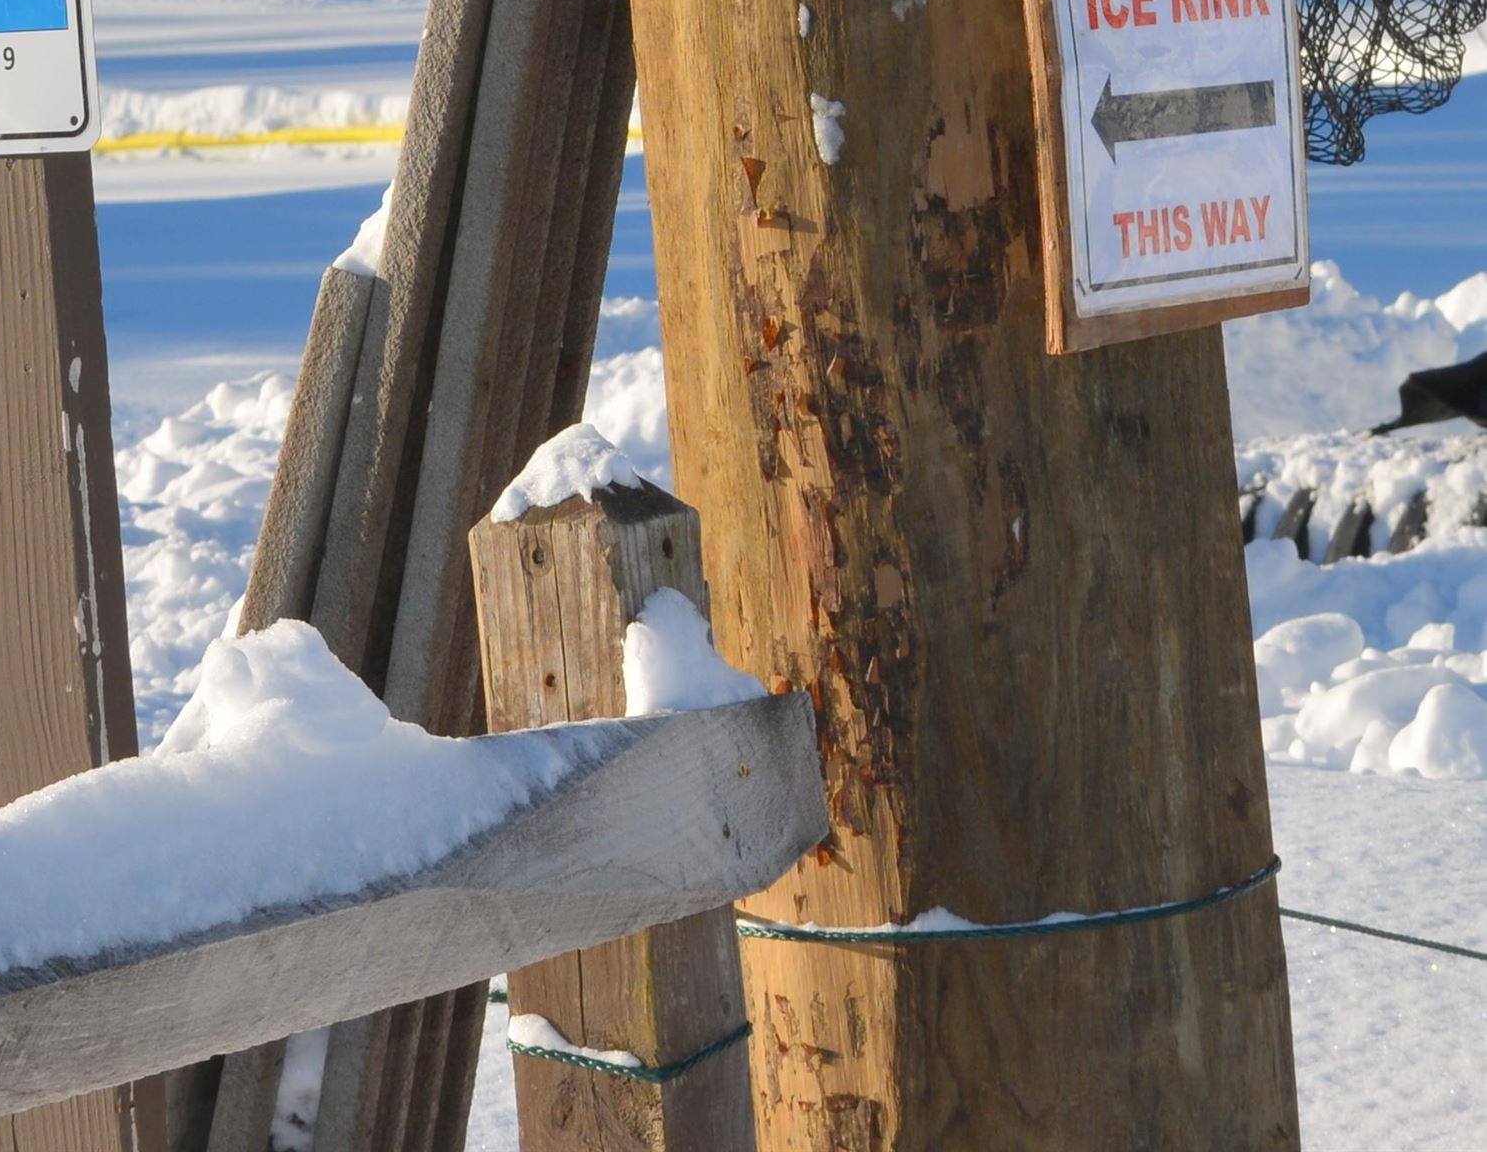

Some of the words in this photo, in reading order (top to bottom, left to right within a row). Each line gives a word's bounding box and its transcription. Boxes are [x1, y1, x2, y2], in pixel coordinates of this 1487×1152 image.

[2, 46, 16, 71] 9
[1113, 204, 1193, 259] THIS
[1200, 195, 1271, 246] WAY
